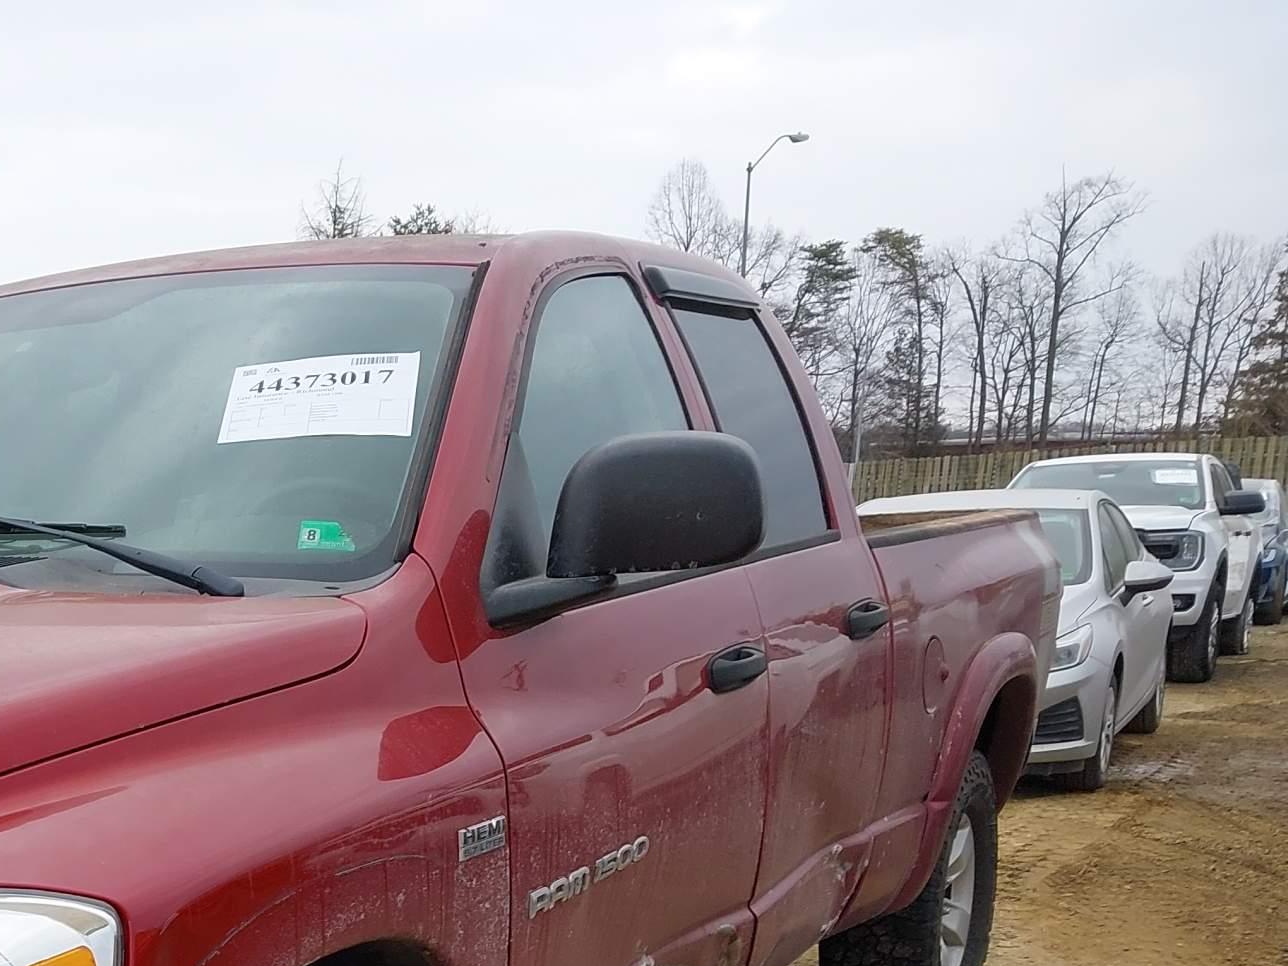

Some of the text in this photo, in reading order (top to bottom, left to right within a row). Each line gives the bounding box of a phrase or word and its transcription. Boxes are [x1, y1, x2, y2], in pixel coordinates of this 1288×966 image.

[249, 369, 395, 394] 44373017
[307, 529, 316, 541] 8
[463, 819, 505, 845] HEMI
[528, 835, 650, 920] RAM 1500
